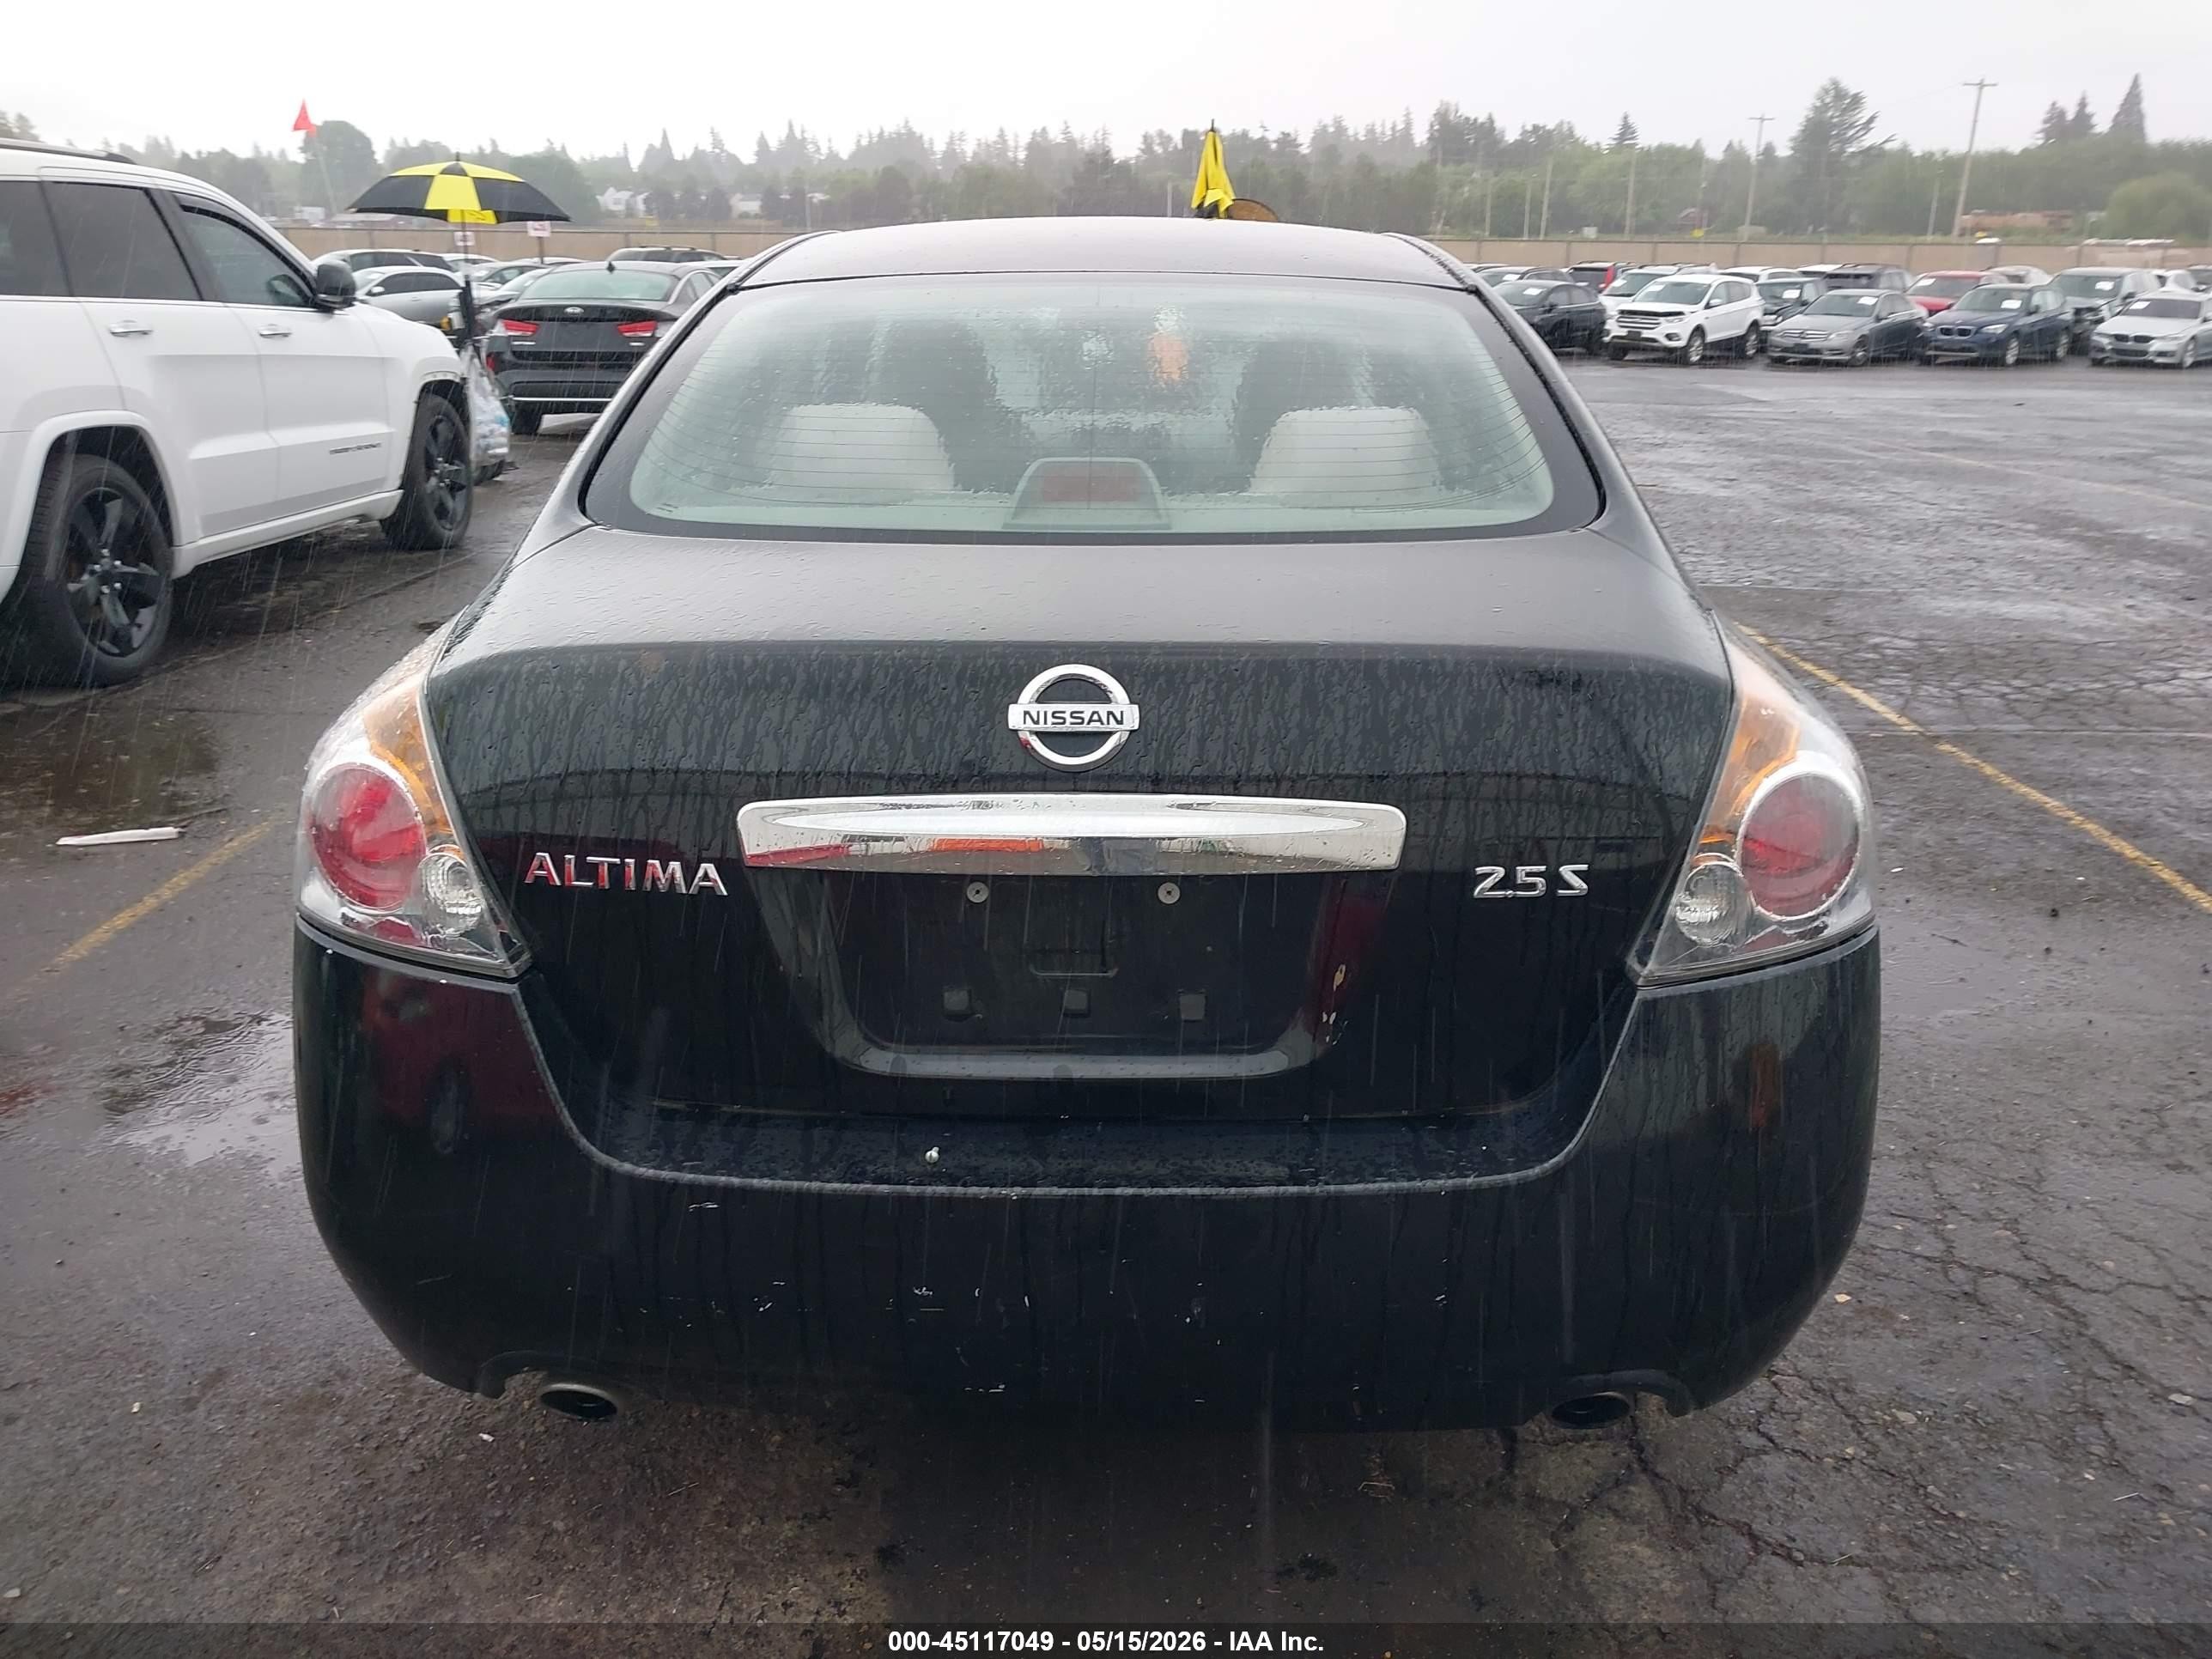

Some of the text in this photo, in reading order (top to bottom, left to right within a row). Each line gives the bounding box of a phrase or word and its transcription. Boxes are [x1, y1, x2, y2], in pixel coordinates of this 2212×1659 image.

[1023, 710, 1124, 726] NISSAN
[524, 852, 729, 896] ALTIMA
[1474, 864, 1589, 898] 2.5 S
